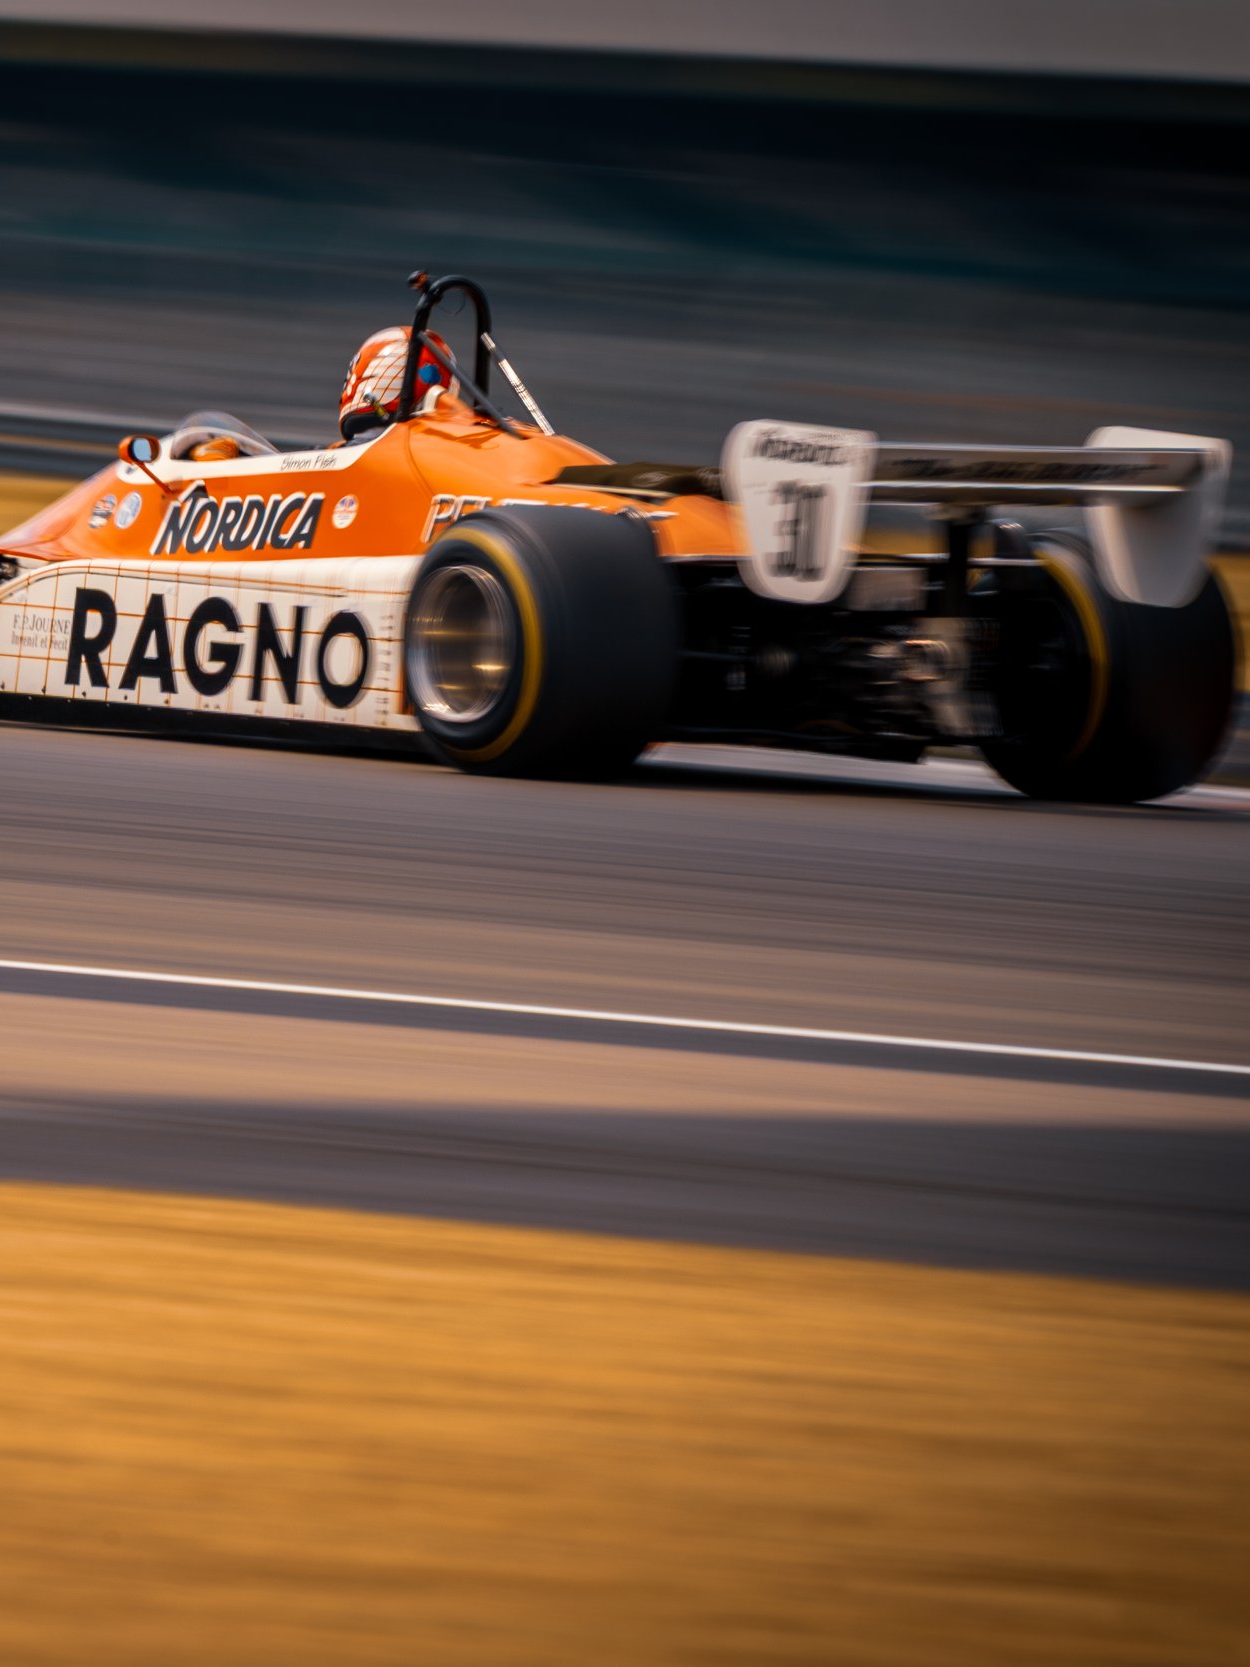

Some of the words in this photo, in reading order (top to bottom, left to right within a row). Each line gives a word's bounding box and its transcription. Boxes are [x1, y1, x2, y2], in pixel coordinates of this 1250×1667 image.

[280, 456, 311, 471] Simon
[313, 454, 337, 469] Fish
[149, 480, 326, 556] NORDICA
[64, 586, 372, 710] RAGNO
